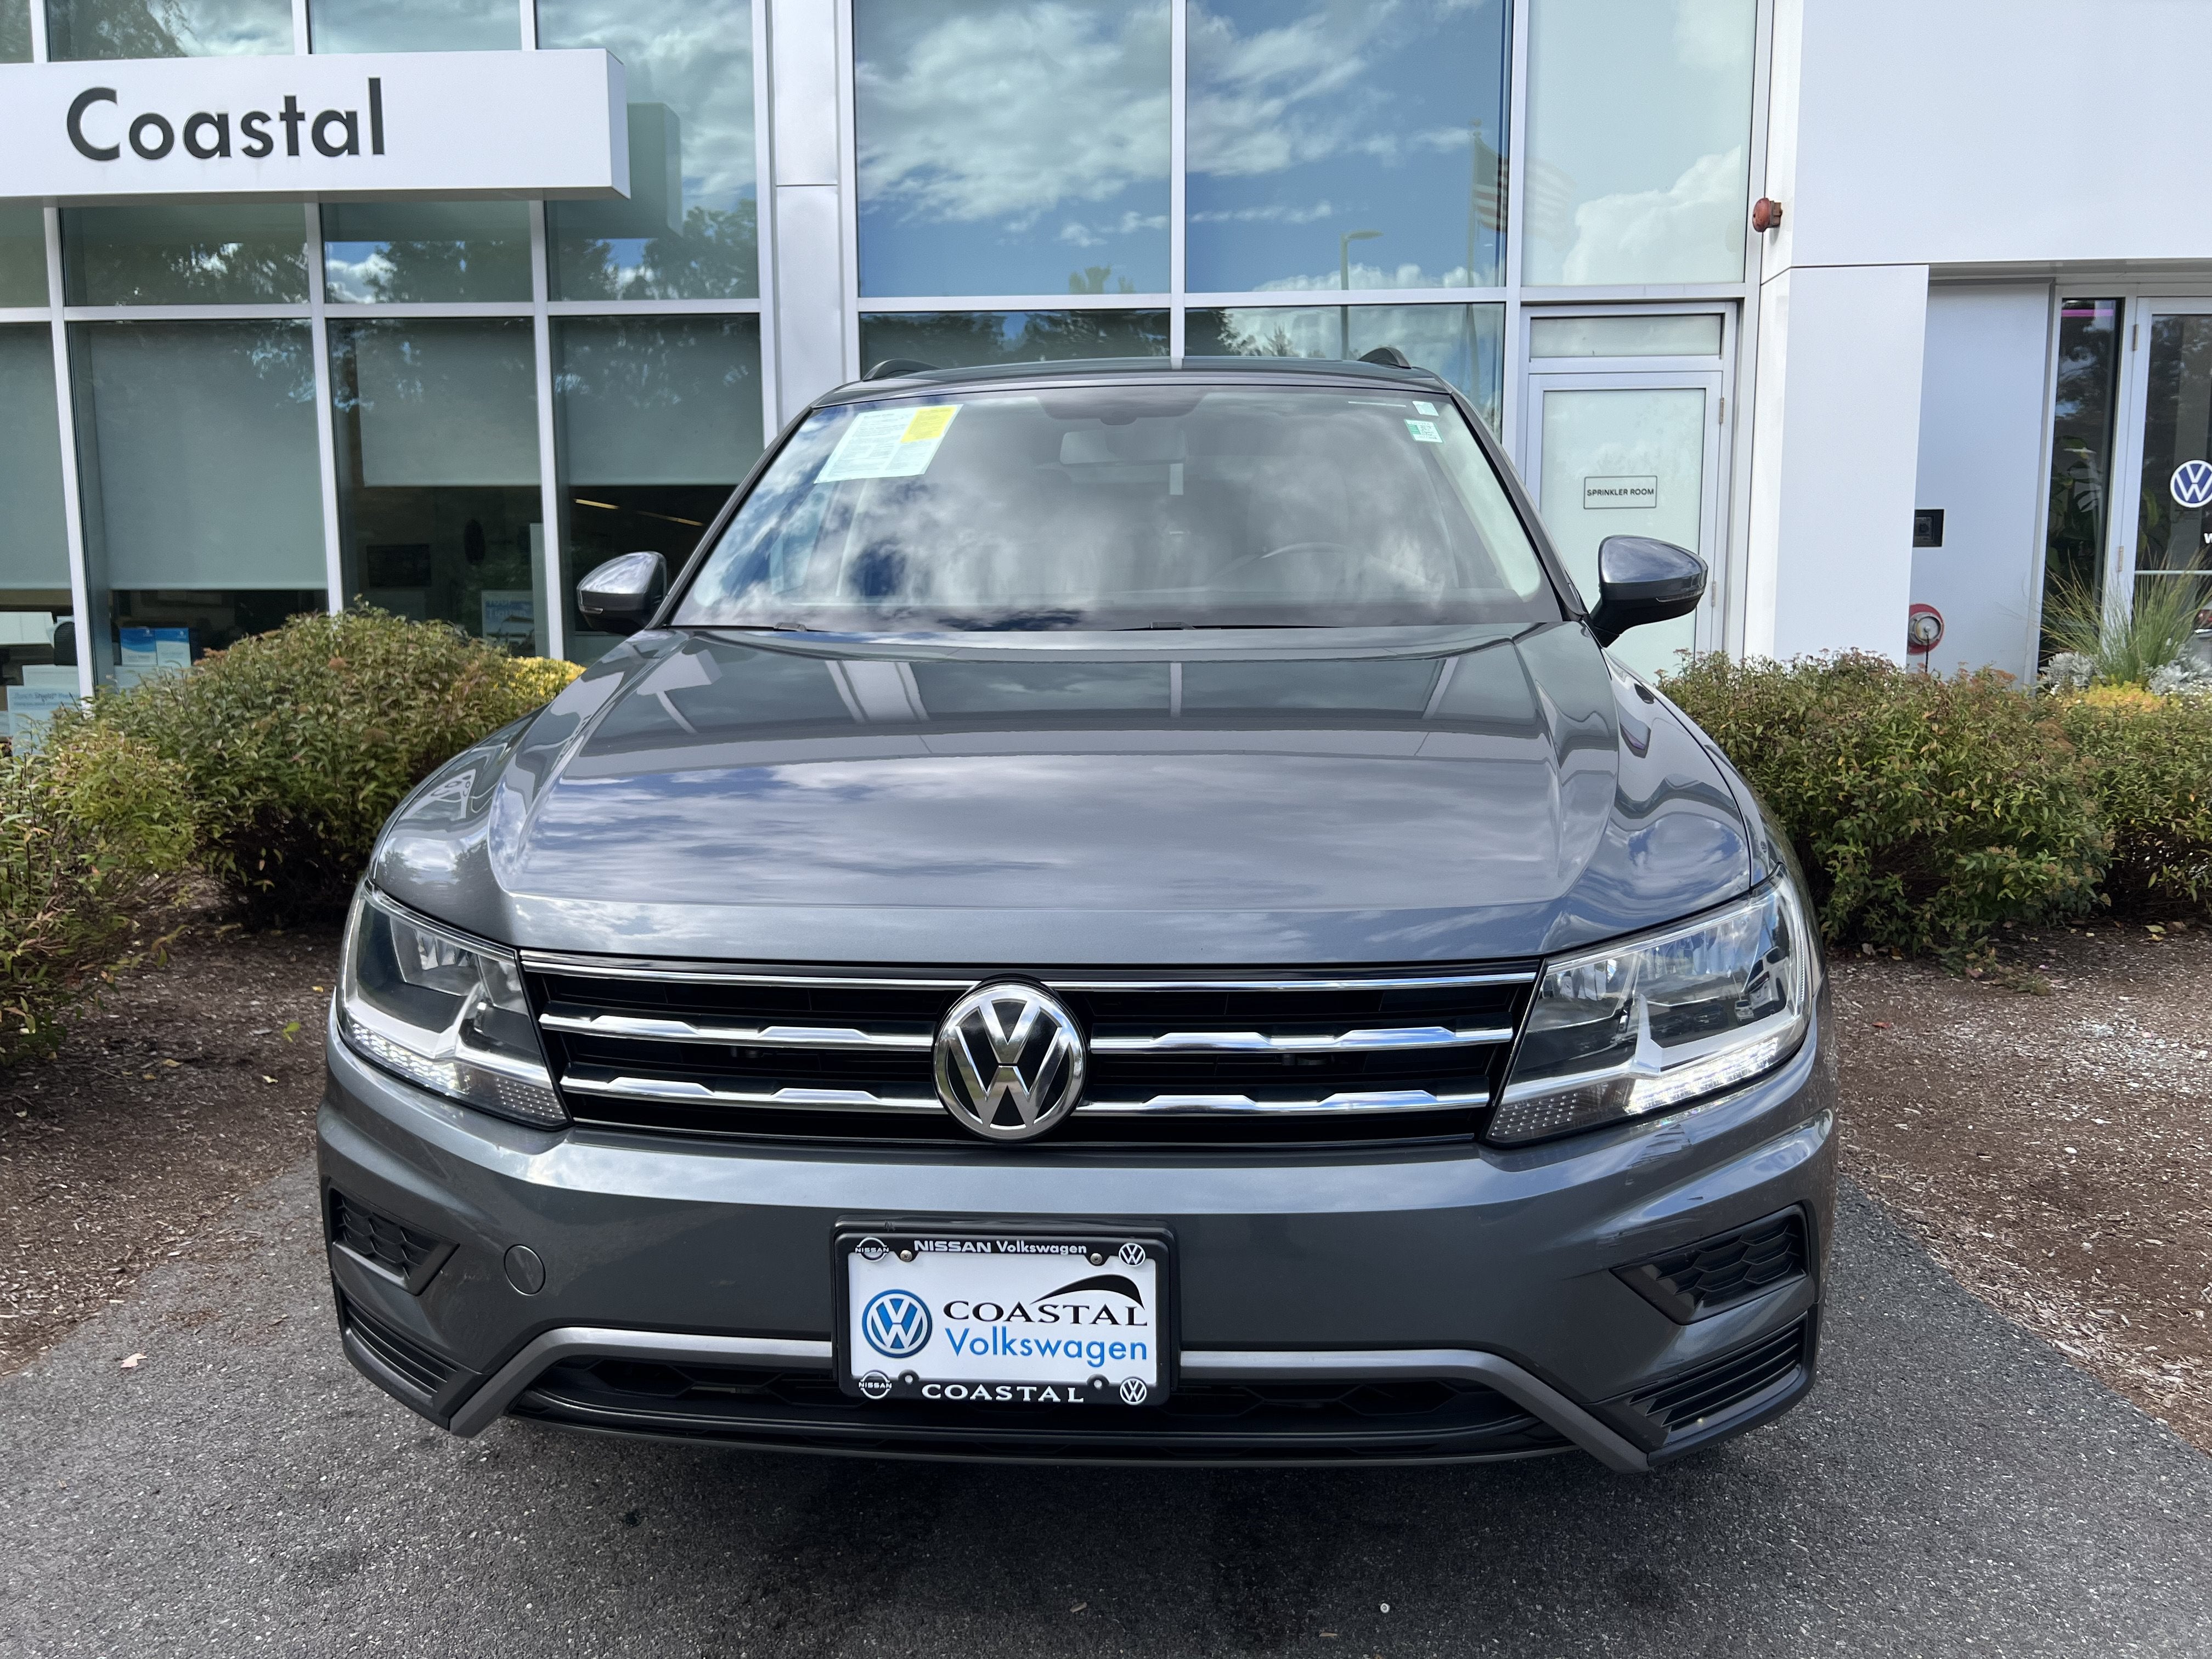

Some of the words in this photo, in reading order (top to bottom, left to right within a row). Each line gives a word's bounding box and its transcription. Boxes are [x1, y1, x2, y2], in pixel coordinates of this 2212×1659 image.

[65, 77, 385, 161] Coastal
[913, 1240, 991, 1253] NISSAN
[996, 1239, 1087, 1256] Volkswagen
[943, 1300, 1148, 1327] COASTAL
[944, 1325, 1148, 1368] Volkswagen
[921, 1384, 1084, 1403] COASTAL
